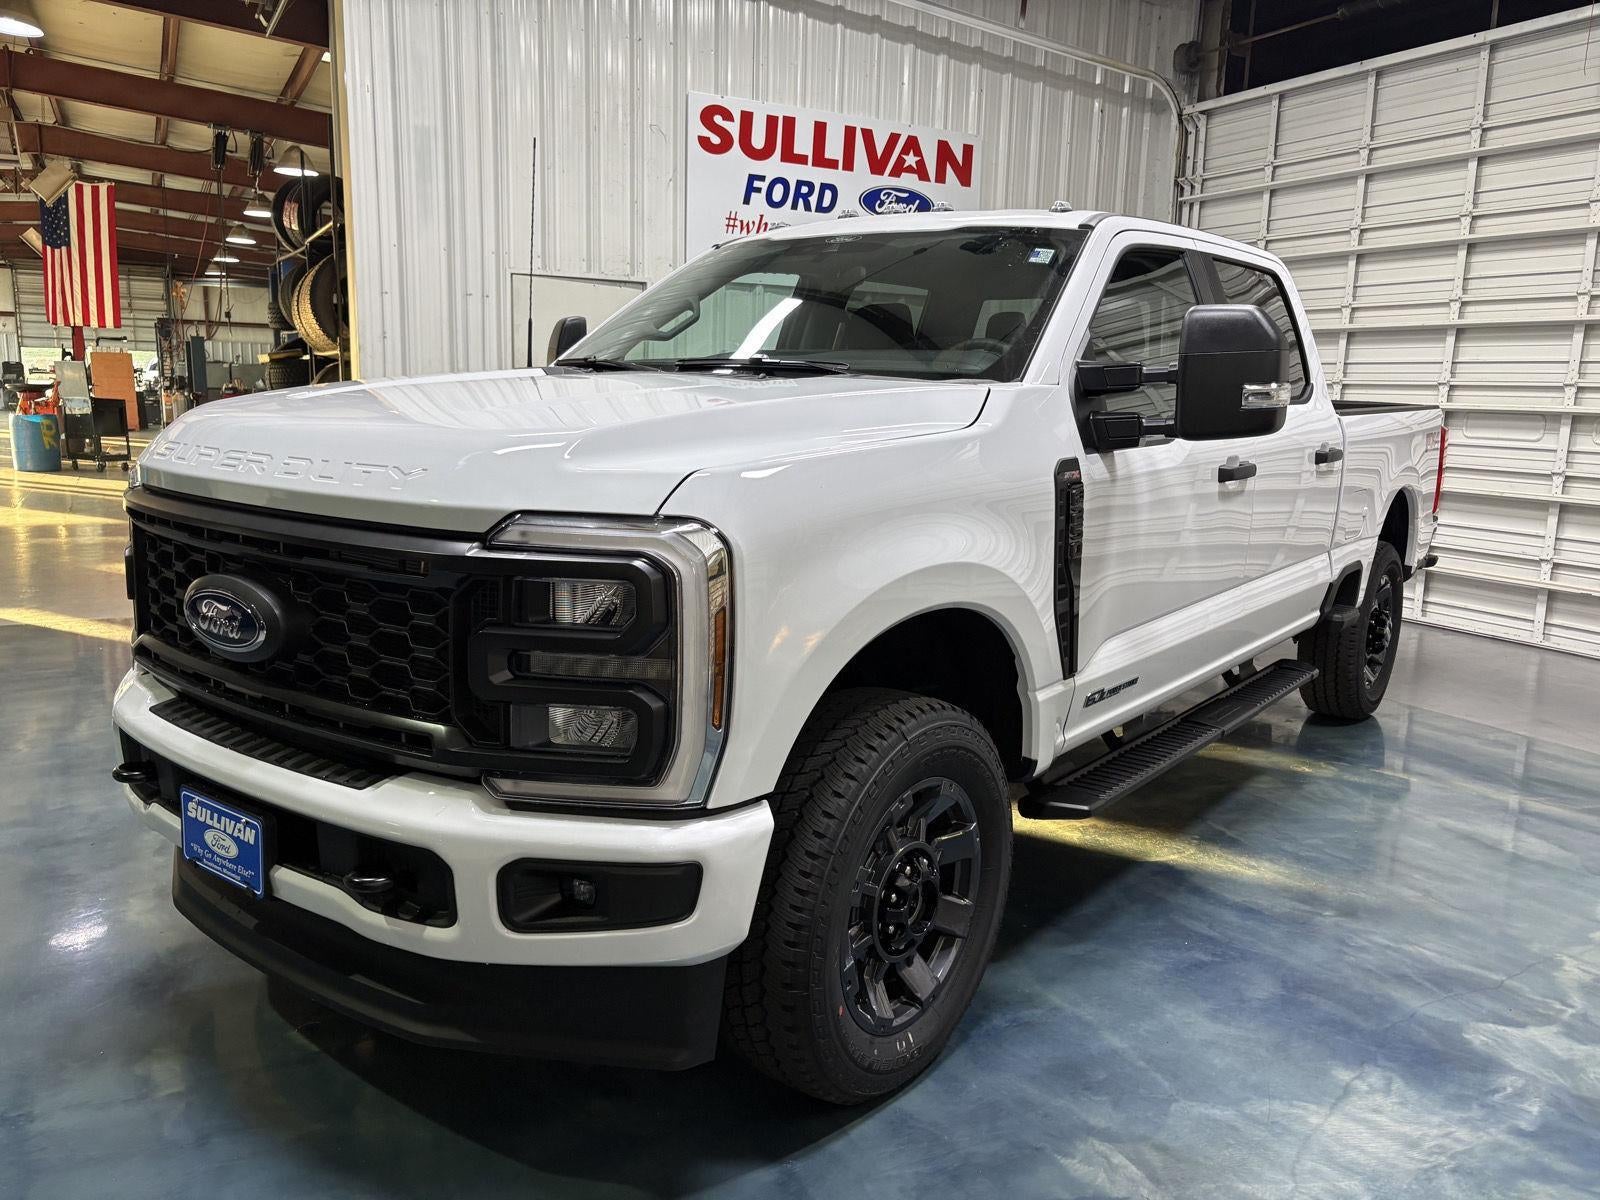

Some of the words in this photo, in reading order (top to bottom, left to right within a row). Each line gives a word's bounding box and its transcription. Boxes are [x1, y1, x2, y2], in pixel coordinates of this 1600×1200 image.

[697, 104, 974, 188] SULLIVAN
[742, 173, 839, 214] FORD
[152, 440, 274, 475] SUPER
[273, 455, 429, 490] DUTY
[199, 599, 242, 639] Ford
[187, 801, 256, 845] SULLIVAN
